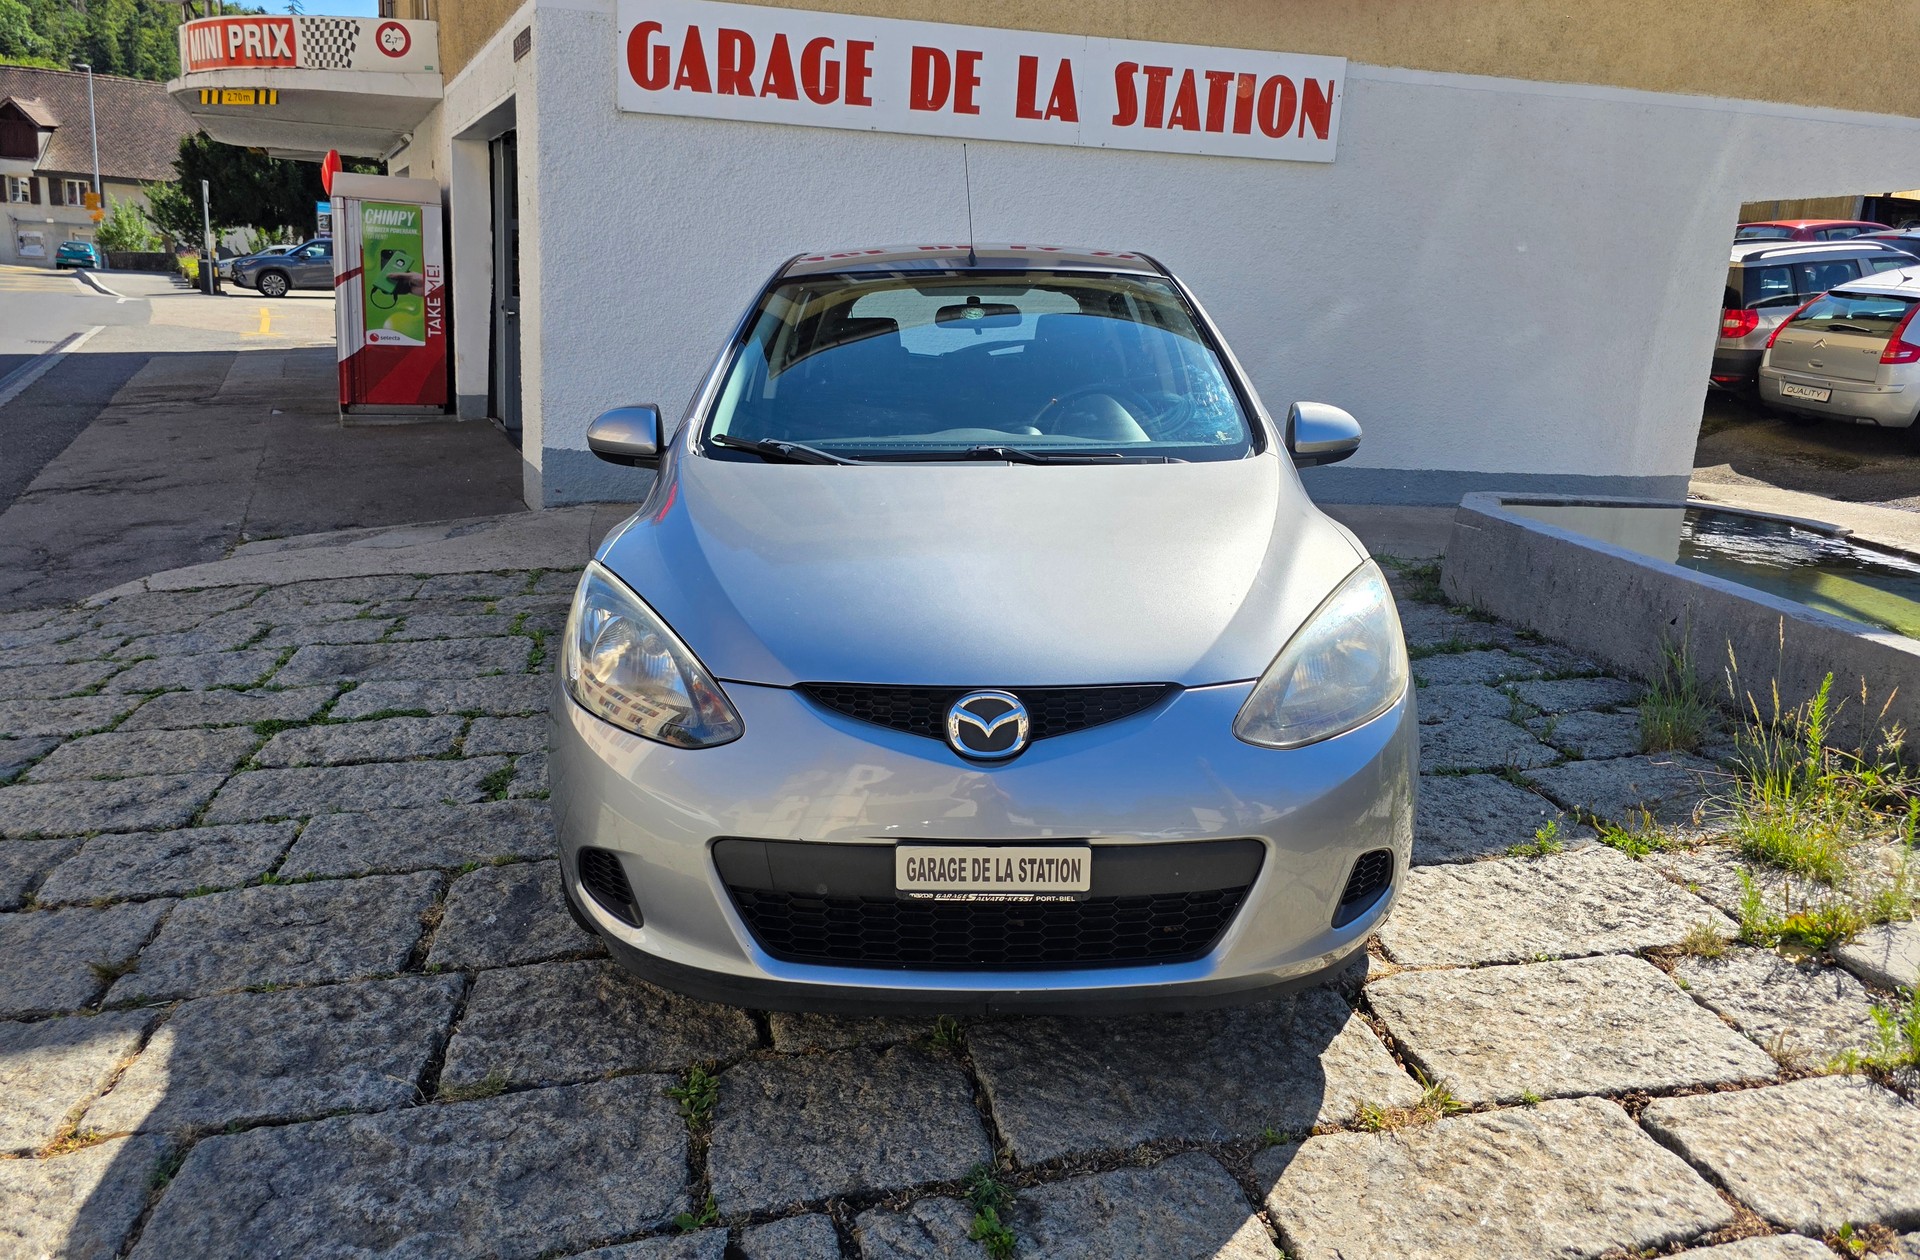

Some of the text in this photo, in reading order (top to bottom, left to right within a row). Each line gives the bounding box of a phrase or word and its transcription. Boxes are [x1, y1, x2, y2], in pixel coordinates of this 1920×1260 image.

[189, 23, 293, 62] MINI PRIX
[626, 20, 1335, 141] GARAGE DE LA STATION
[365, 208, 415, 226] CHIMPY
[425, 264, 441, 338] TAKE ME!
[1787, 385, 1823, 398] QUALITY
[906, 856, 1081, 883] GARAGE DE LA STATION
